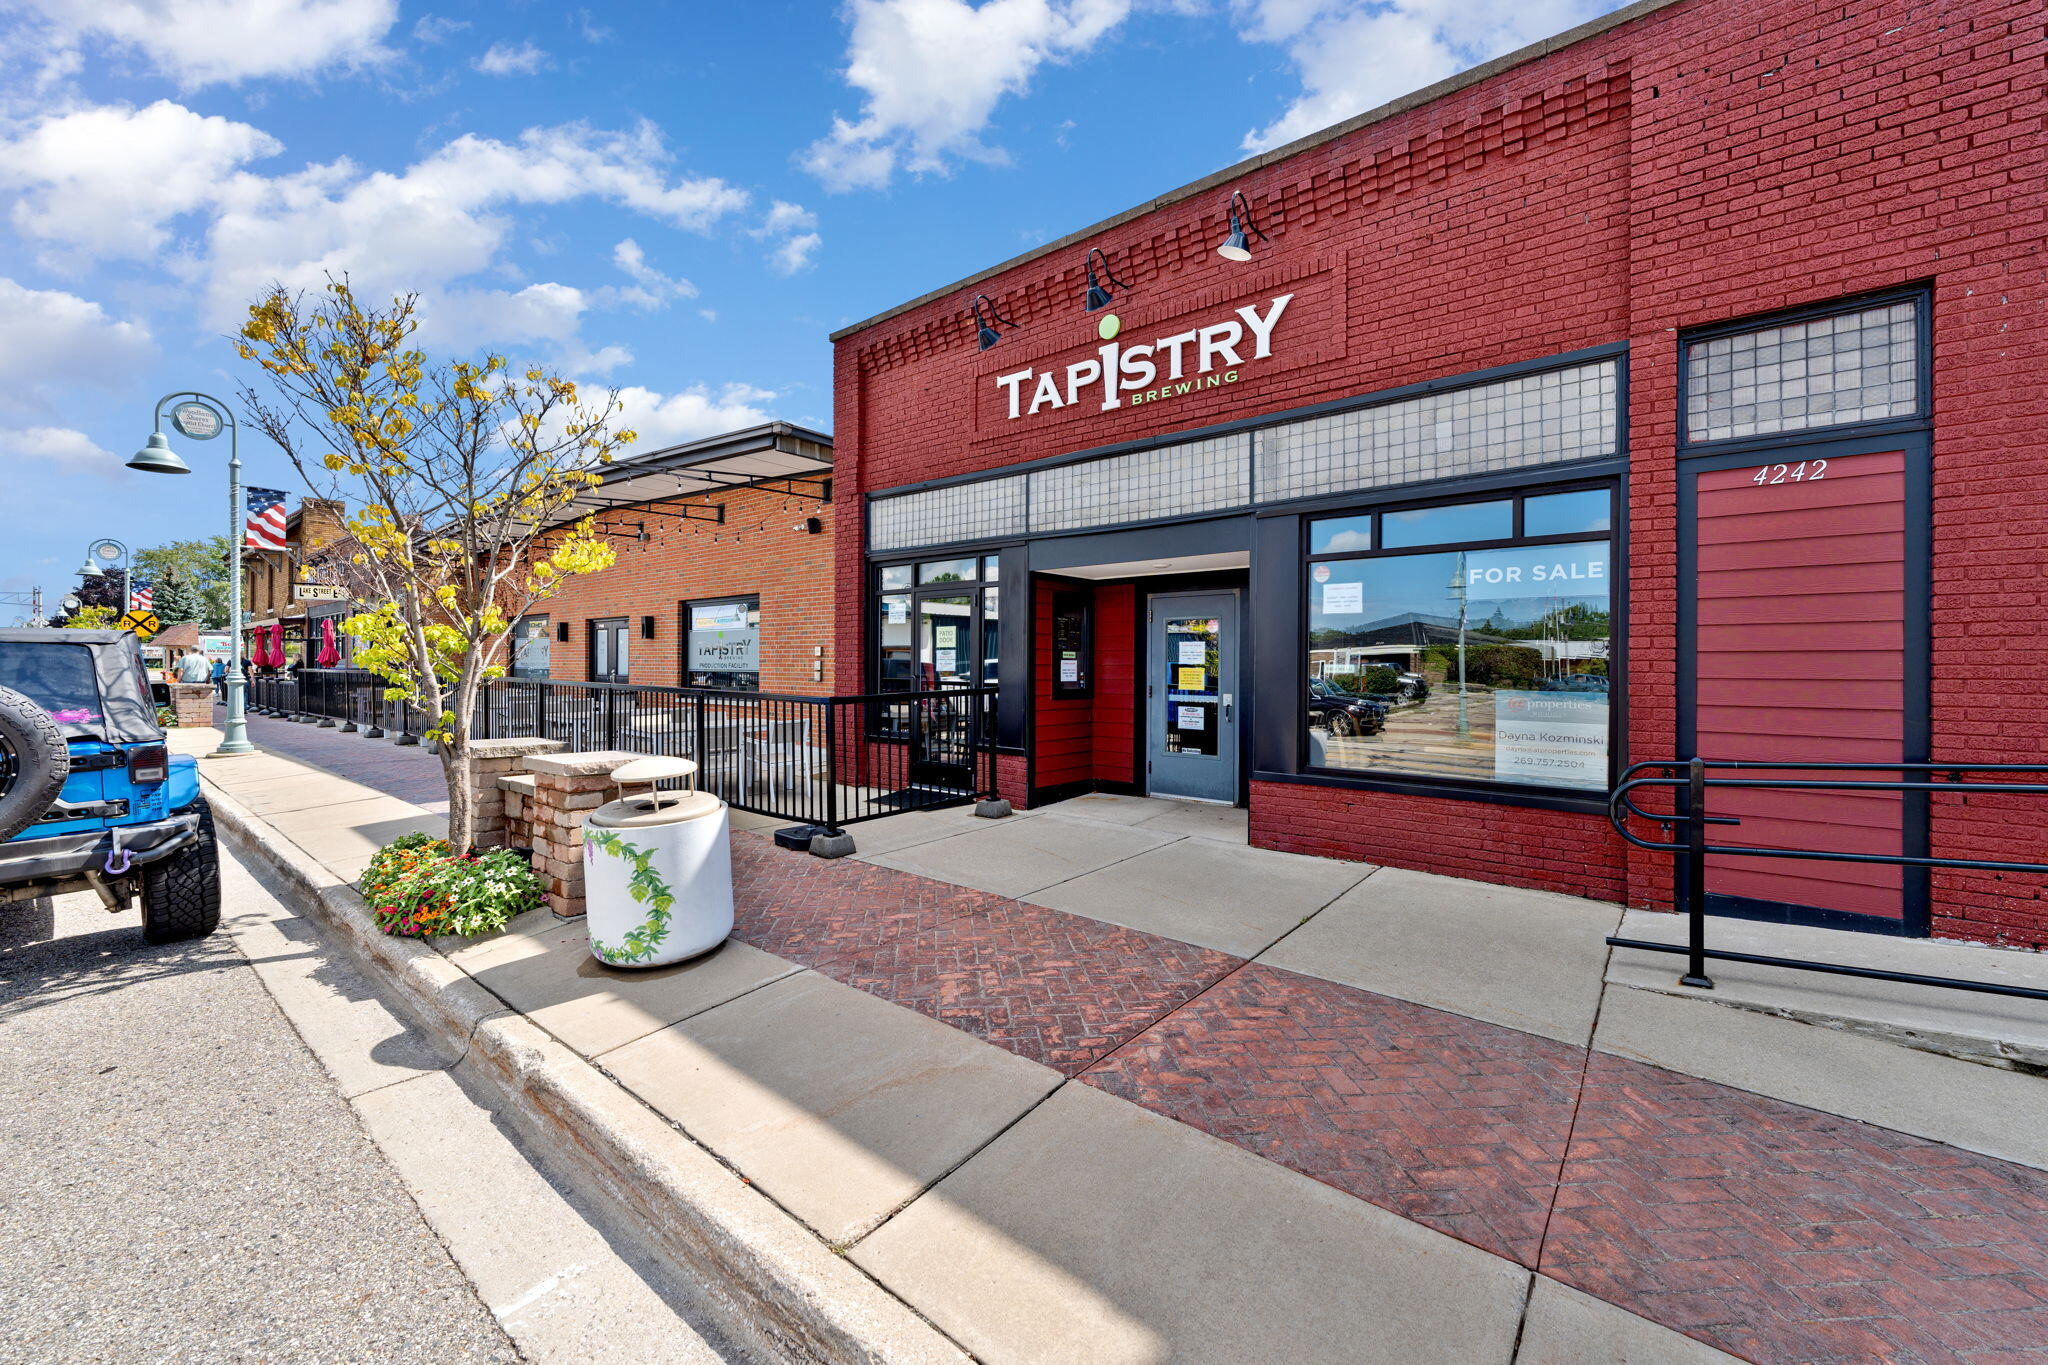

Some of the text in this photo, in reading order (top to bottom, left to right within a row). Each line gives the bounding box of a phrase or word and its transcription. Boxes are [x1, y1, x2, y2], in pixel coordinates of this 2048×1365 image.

[997, 294, 1294, 418] TAPISTRY
[1131, 370, 1239, 406] BREWING
[1753, 460, 1828, 486] 4242
[1469, 561, 1604, 585] FOR SALE
[299, 587, 312, 597] LAKE
[313, 587, 332, 598] STREET
[1498, 730, 1605, 745] Dayna Kozminski
